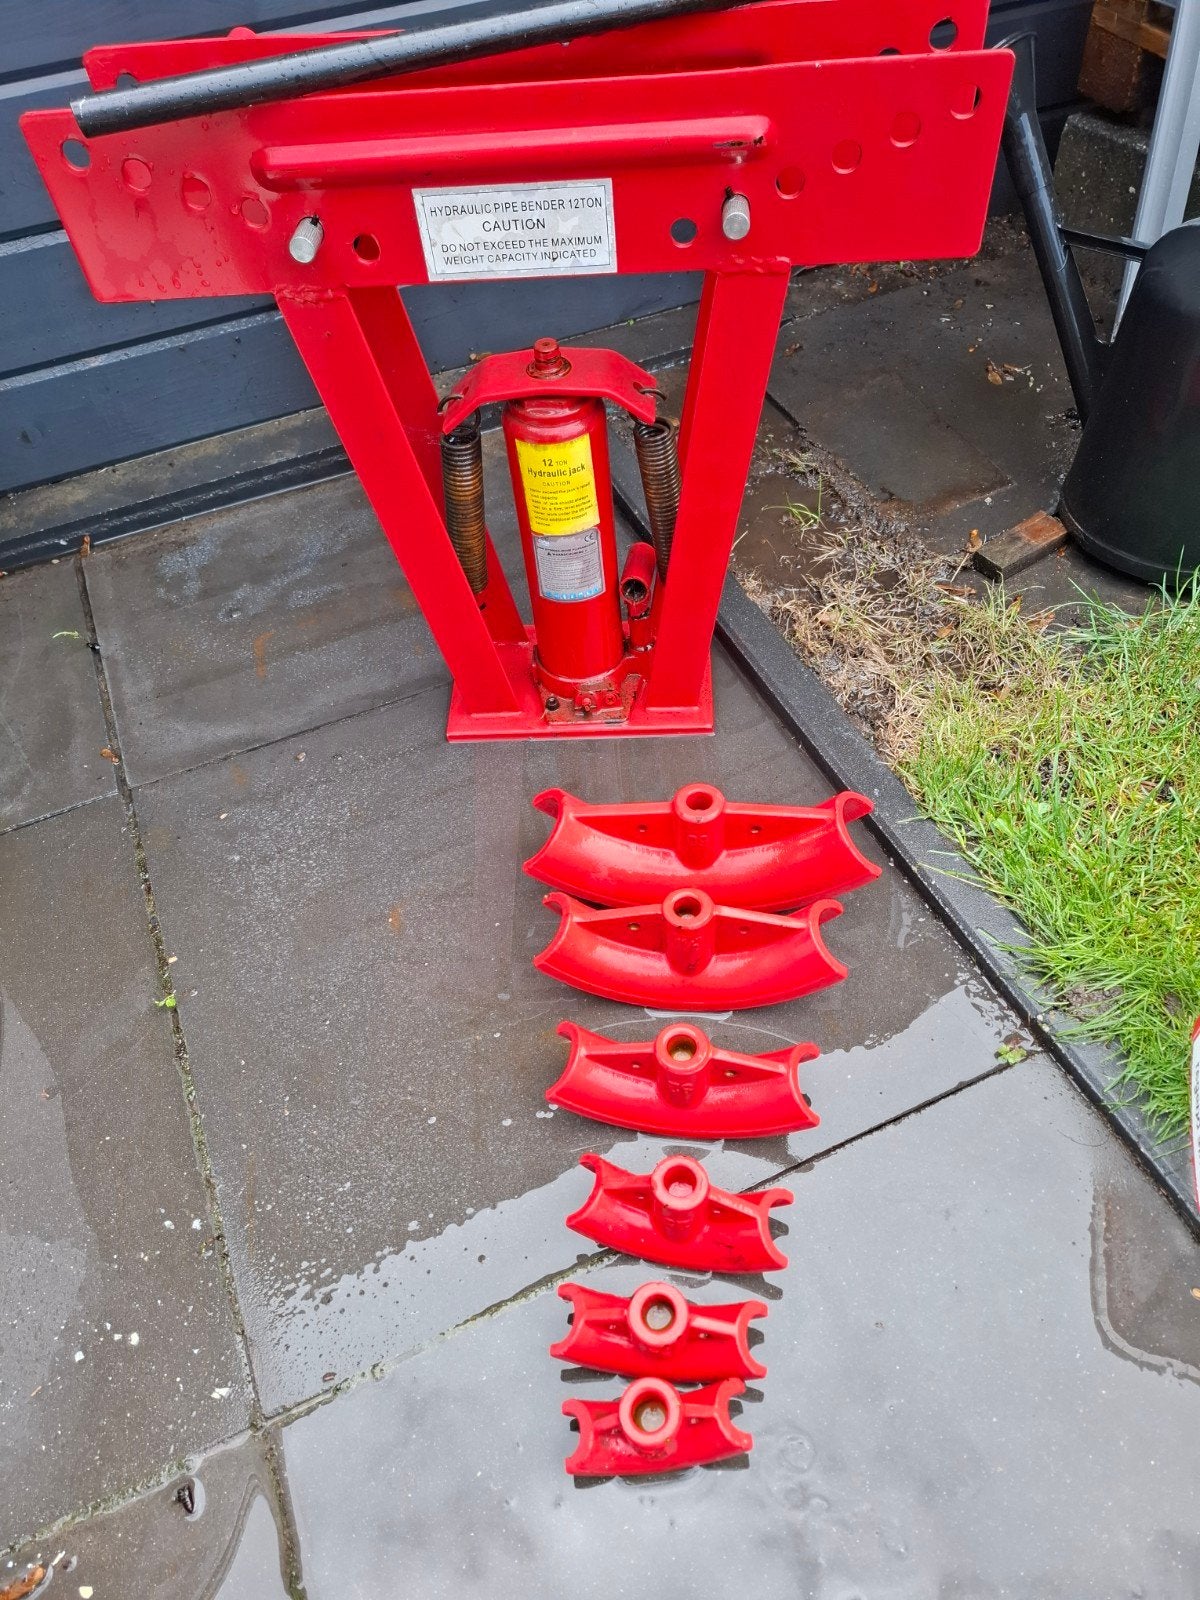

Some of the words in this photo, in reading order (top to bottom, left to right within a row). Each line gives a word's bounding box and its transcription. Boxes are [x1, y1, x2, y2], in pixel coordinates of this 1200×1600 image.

[430, 203, 492, 217] HYDRAULIC
[493, 201, 518, 213] PIPE
[521, 198, 566, 212] BENDER
[568, 197, 602, 209] 12TON
[482, 218, 546, 232] CAUTION
[441, 244, 457, 253] DO
[459, 242, 481, 252] NOT
[484, 240, 525, 251] EXCEED
[528, 238, 549, 248] THE
[551, 235, 602, 247] MAXIMUM
[443, 255, 485, 266] WEIGHT
[487, 252, 538, 263] CAPACITY
[541, 248, 597, 261] INDICATED
[527, 467, 567, 478] Hydraulic
[568, 463, 586, 475] jack
[542, 458, 554, 467] 12
